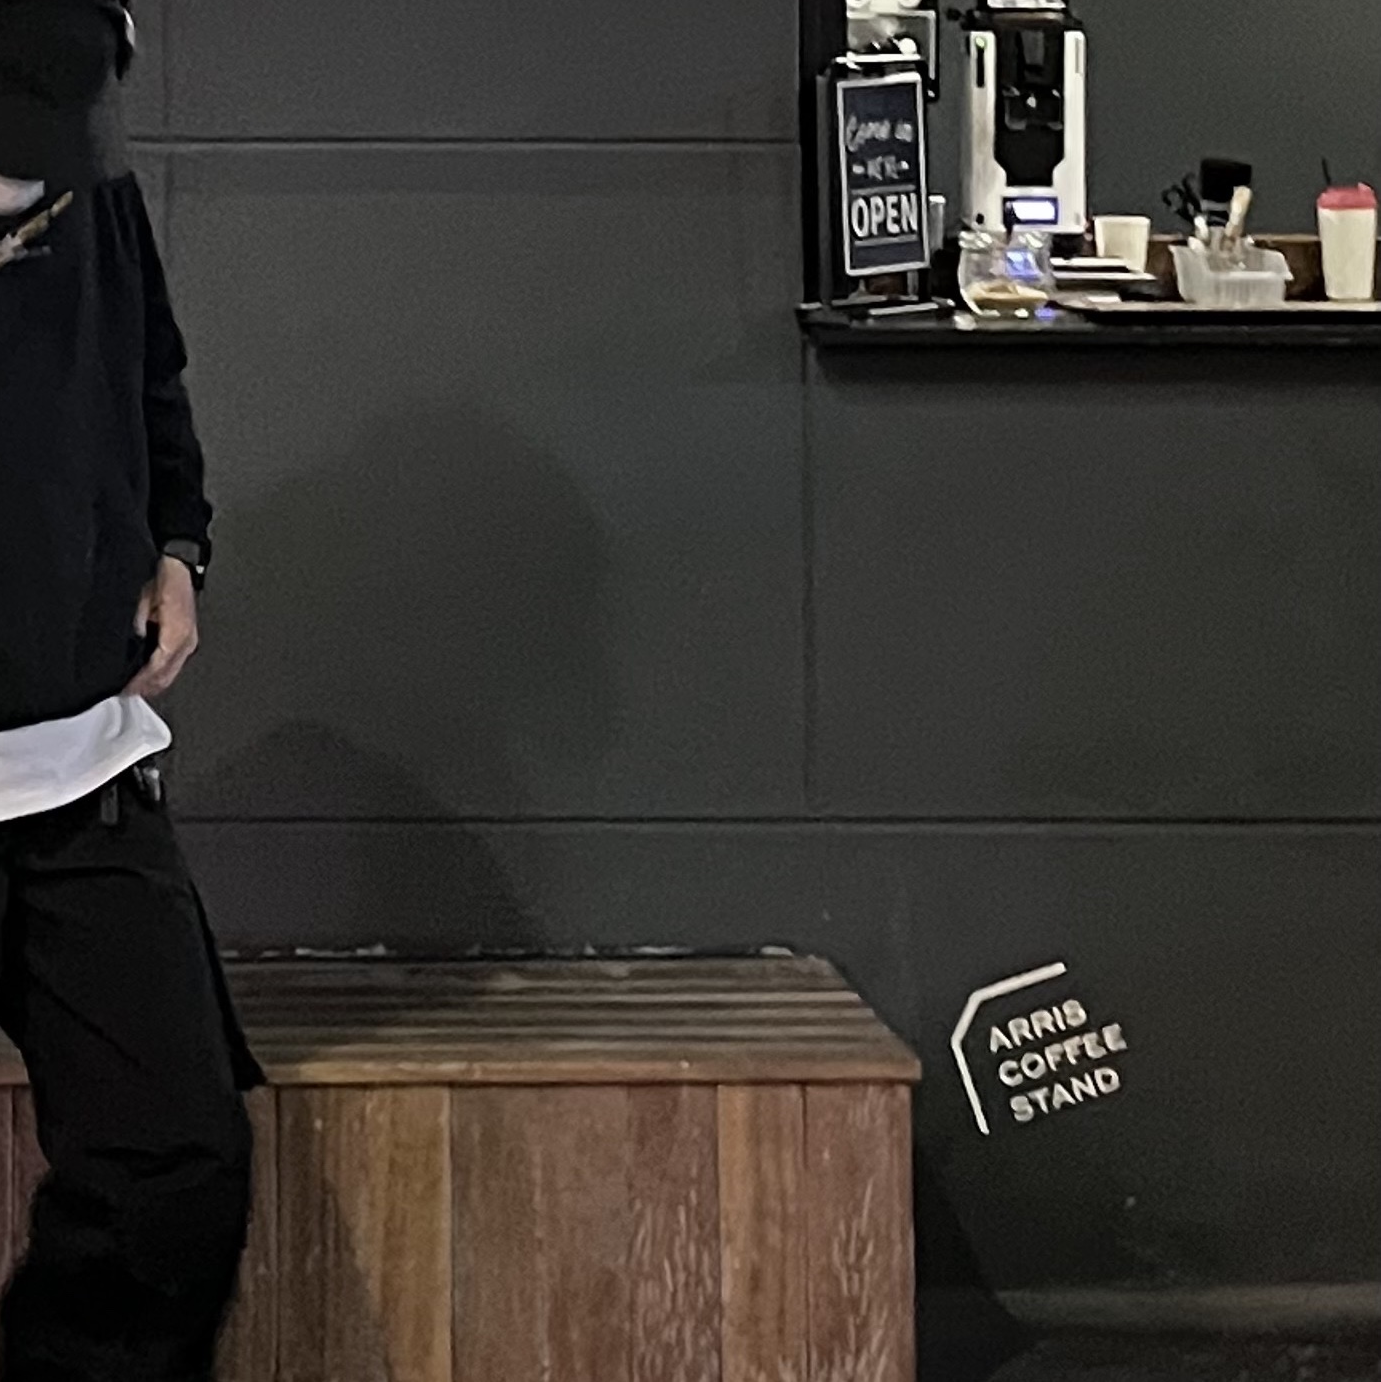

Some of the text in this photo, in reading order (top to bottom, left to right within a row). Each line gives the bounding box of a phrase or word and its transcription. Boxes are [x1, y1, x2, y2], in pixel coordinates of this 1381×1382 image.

[851, 193, 918, 238] OPEN
[989, 999, 1088, 1054] ARRIS
[998, 1022, 1128, 1088] COFFEE
[1009, 1066, 1121, 1123] STAND
